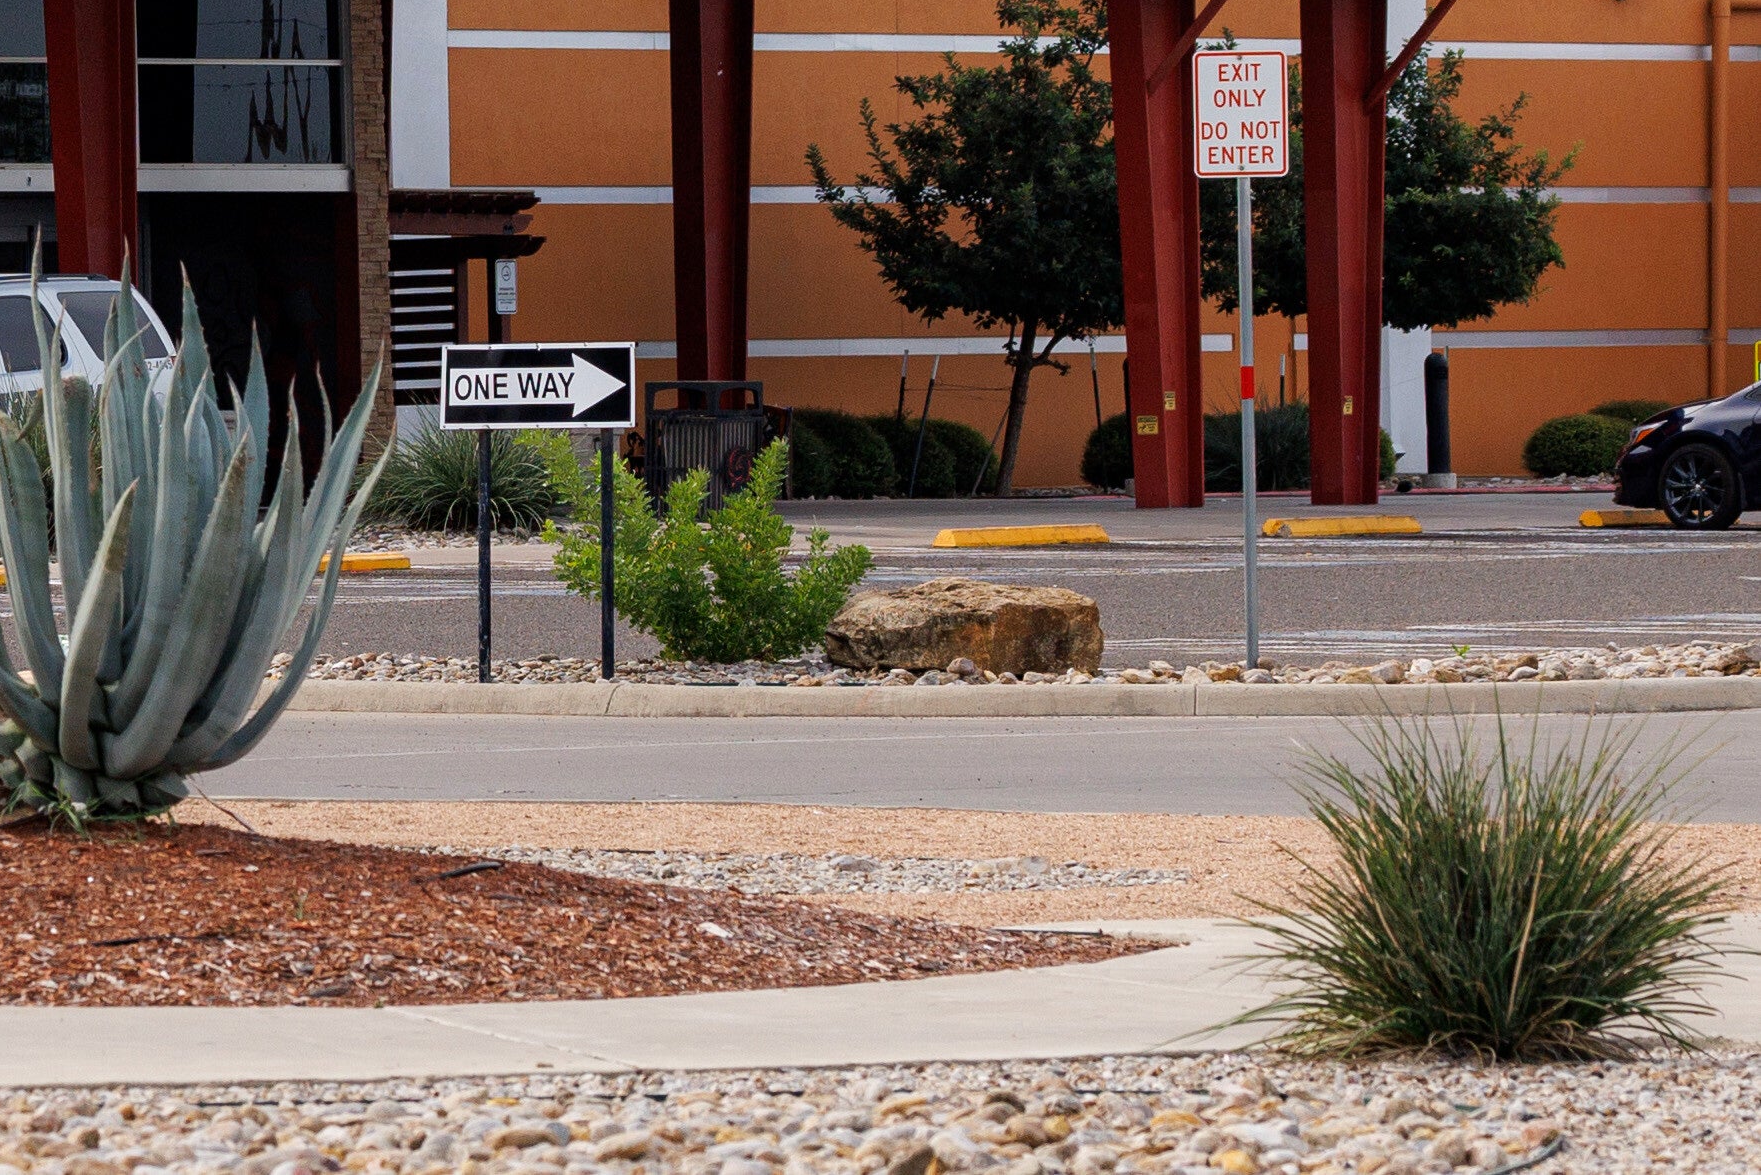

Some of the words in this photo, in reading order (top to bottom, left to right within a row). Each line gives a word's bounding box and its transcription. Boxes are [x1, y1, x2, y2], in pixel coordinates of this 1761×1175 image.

[1217, 63, 1262, 82] EXIT
[1213, 88, 1267, 108] ONLY
[1201, 121, 1228, 140] DO
[1240, 120, 1281, 140] NOT
[1208, 145, 1274, 165] ENTER
[454, 372, 509, 401] ONE
[517, 372, 576, 400] WAY
